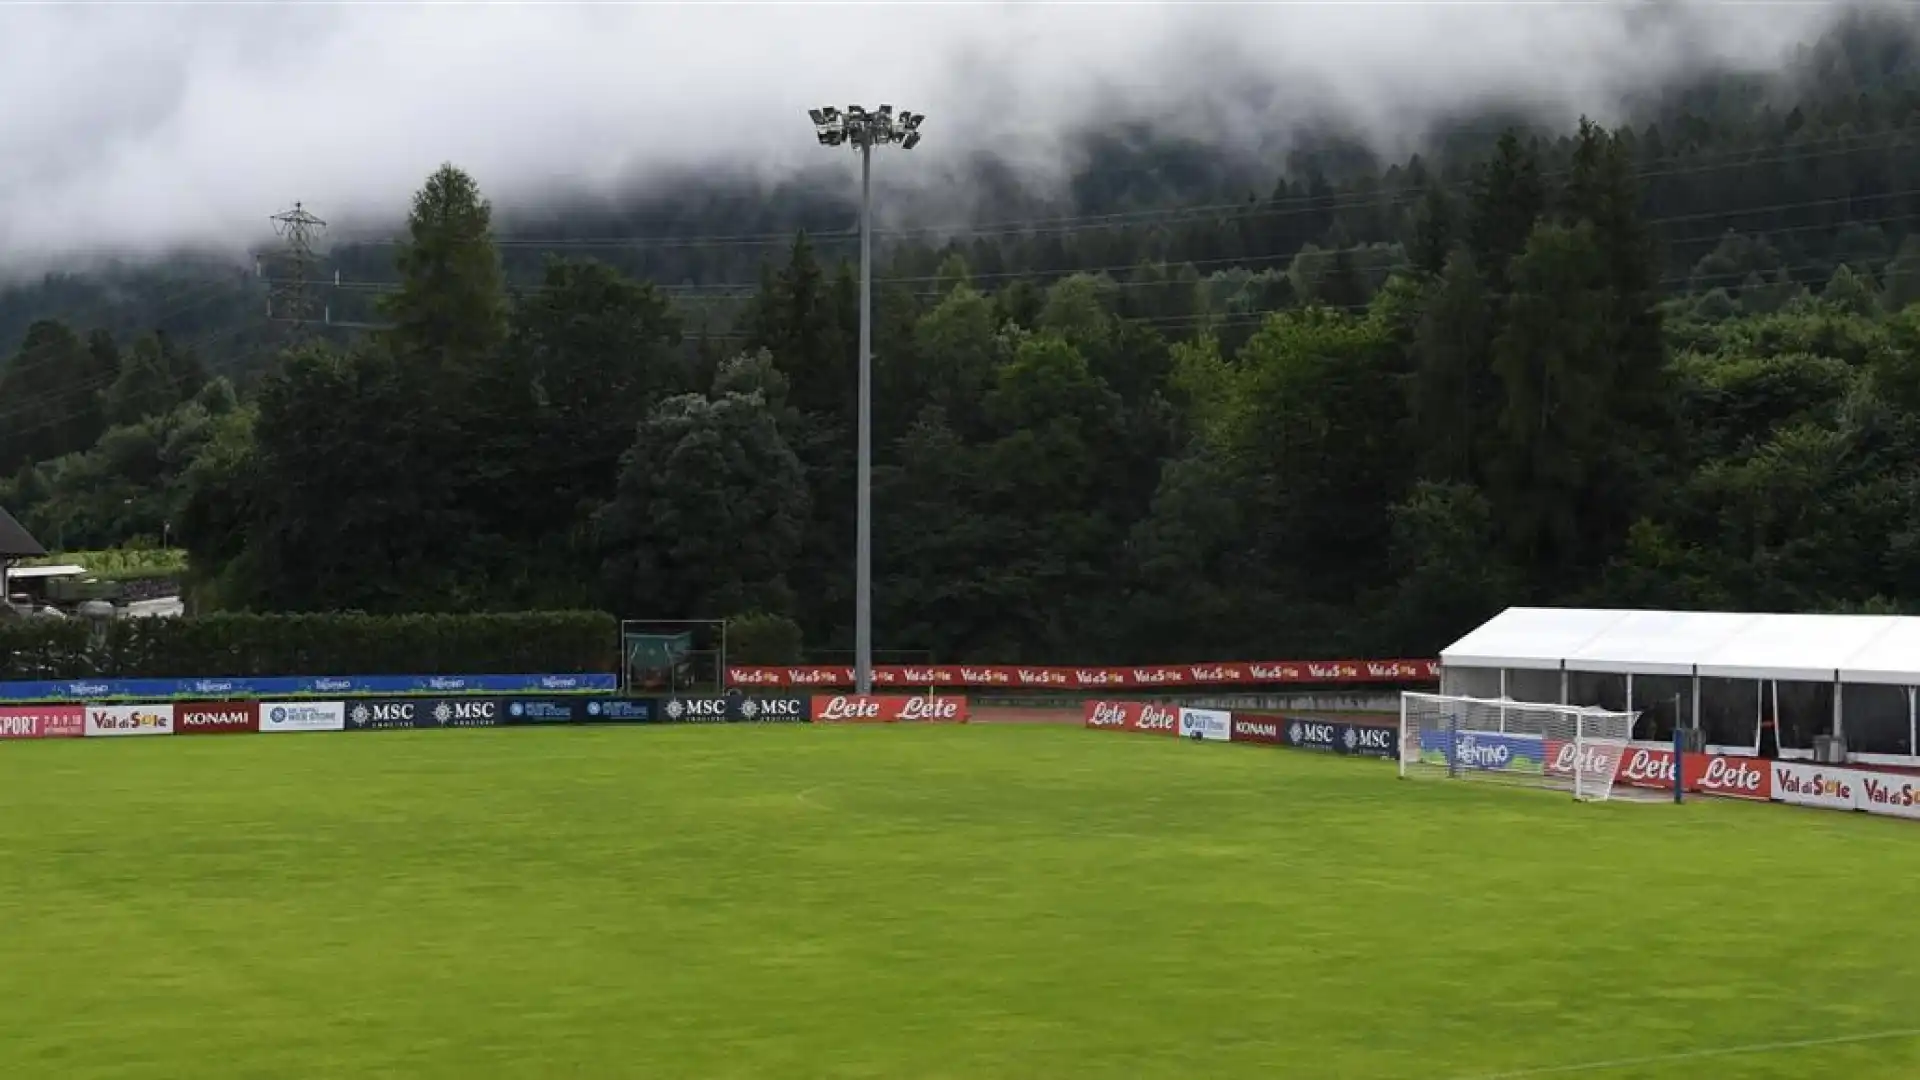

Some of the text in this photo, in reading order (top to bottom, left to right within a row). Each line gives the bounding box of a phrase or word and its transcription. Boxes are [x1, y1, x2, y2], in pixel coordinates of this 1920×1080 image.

[373, 703, 415, 720] MSC
[455, 702, 495, 718] MSC
[686, 699, 726, 714] MSC
[761, 699, 801, 714] MSC
[817, 696, 880, 720] Lete
[894, 696, 957, 720] Lete
[1088, 701, 1126, 725] Lete
[93, 711, 167, 728] Val di Sole
[183, 712, 248, 724] KONAMI
[1135, 705, 1173, 729] Lete
[1236, 721, 1276, 736] KONAMI
[1304, 723, 1333, 742] MSC
[1359, 729, 1389, 748] MSC
[1696, 757, 1761, 790] Lete
[1777, 769, 1850, 798] Val di Sole
[1863, 778, 1887, 803] Val
[1890, 791, 1900, 804] di
